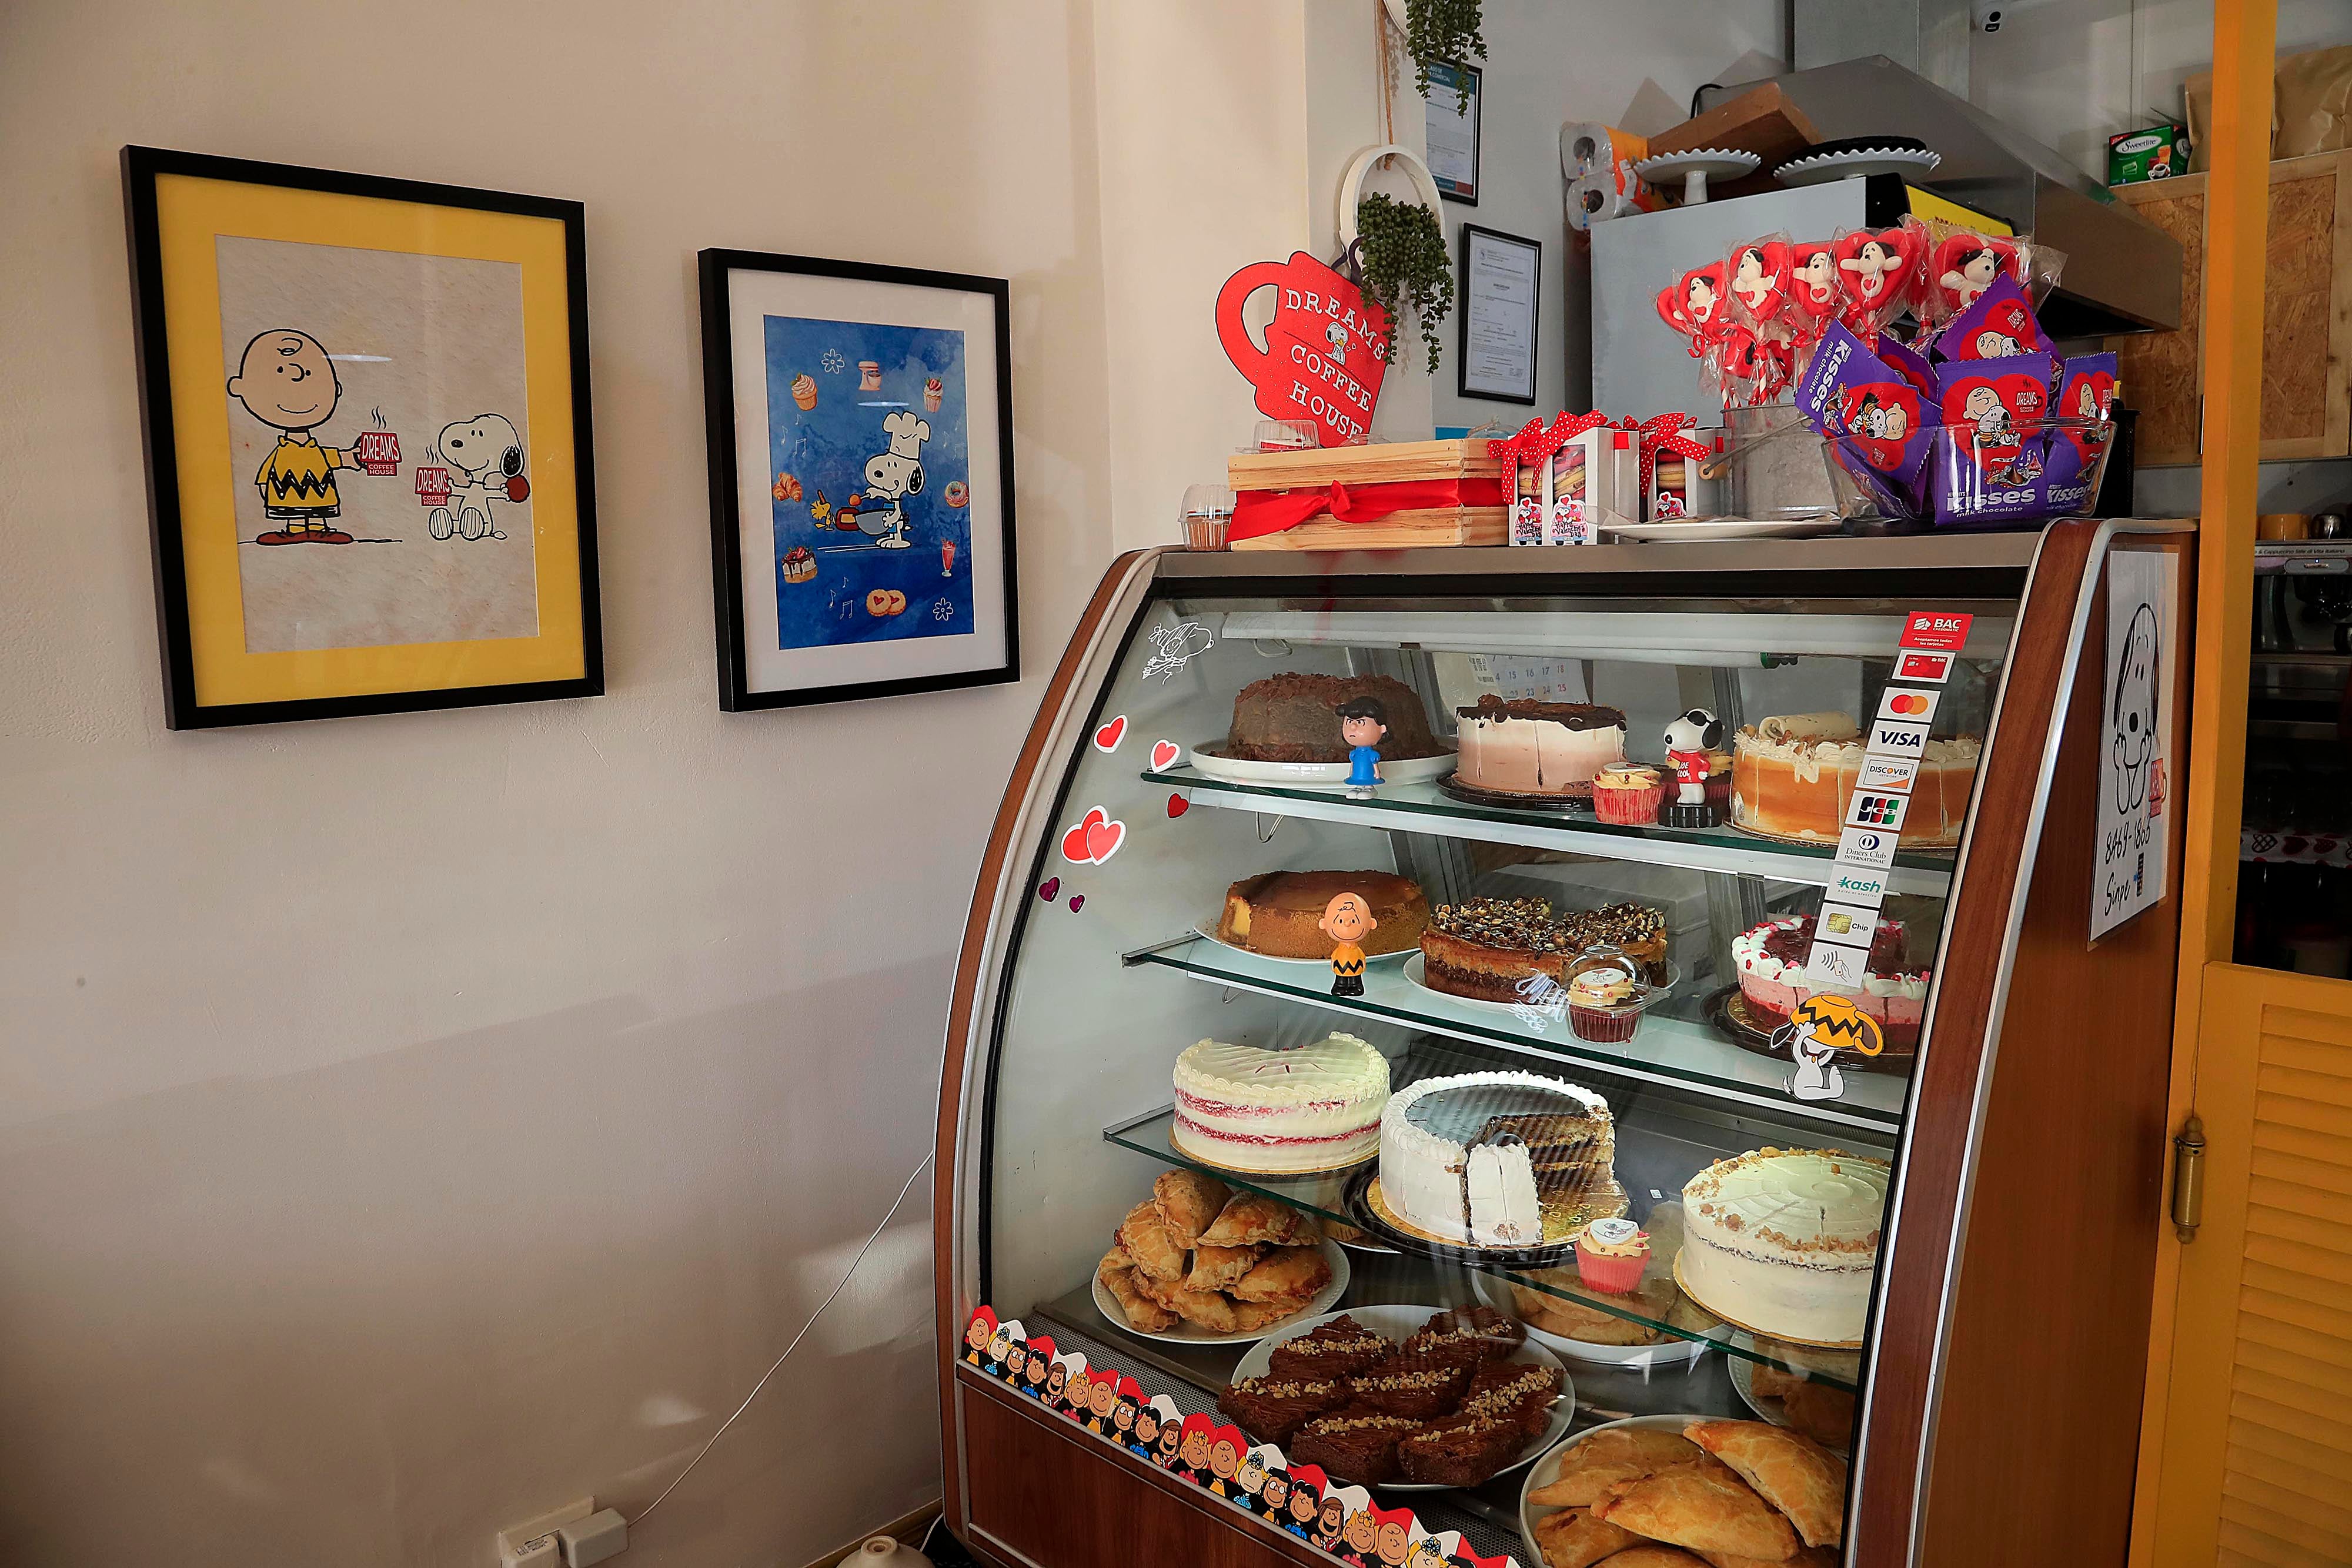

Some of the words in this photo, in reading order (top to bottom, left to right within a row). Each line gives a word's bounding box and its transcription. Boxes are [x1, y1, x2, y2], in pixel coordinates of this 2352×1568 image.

[2122, 139, 2157, 152] Sweetlite
[1285, 289, 1385, 360] DREAMS
[1824, 340, 1834, 358] milk
[1291, 345, 1372, 412] COFFEE
[1809, 358, 1826, 393] chocolate
[2016, 392, 2037, 406] DREAMS
[1289, 380, 1363, 444] HOUSE
[362, 434, 399, 461] DREAMS
[417, 469, 450, 493] DREAMS
[1933, 618, 1962, 629] BAC
[1509, 671, 1516, 680] 15
[1525, 668, 1534, 677] 16
[1542, 666, 1549, 676] 17
[1558, 664, 1564, 673] 18
[1526, 688, 1535, 696] 23
[1543, 686, 1551, 694] 24
[1558, 683, 1566, 692] 25
[1879, 730, 1920, 747] VISA
[1679, 761, 1689, 770] JOE
[1870, 765, 1909, 776] DISCOVER
[1677, 770, 1690, 778] COOL
[1844, 855, 1885, 864] INTERNATIONAL
[1846, 848, 1868, 856] Diners
[1838, 876, 1881, 893] kash
[1852, 923, 1869, 932] Chip
